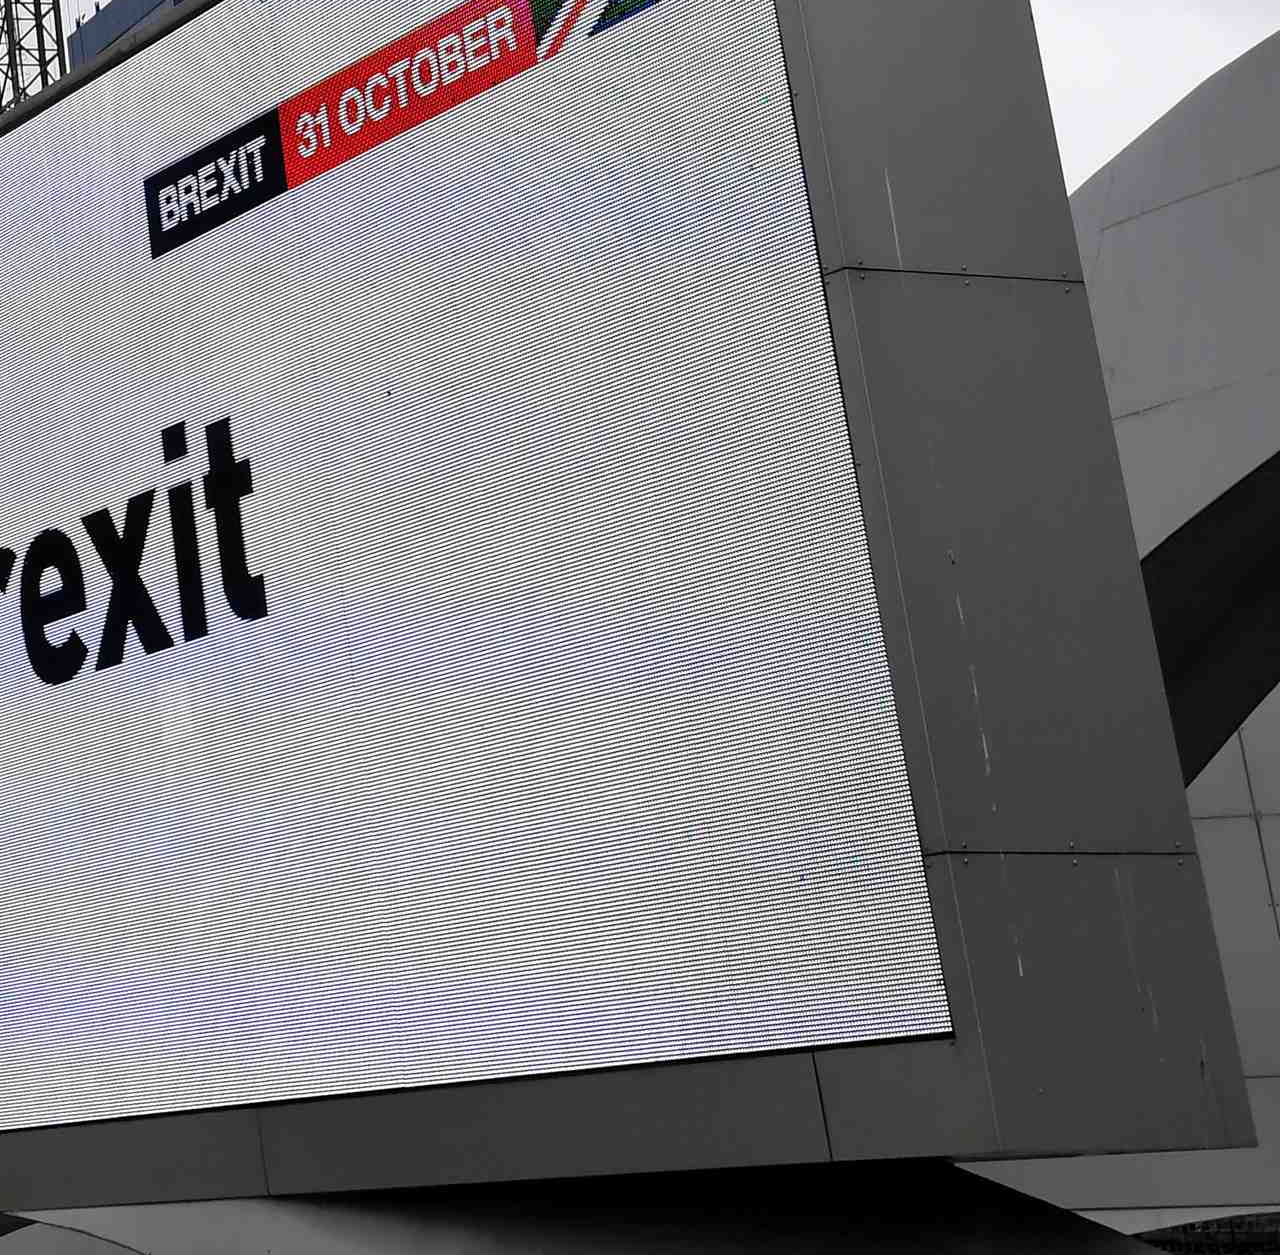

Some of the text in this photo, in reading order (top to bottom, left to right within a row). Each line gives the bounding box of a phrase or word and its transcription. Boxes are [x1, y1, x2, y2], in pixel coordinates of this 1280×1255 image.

[158, 6, 517, 232] BREXIT 31 OCTOBER
